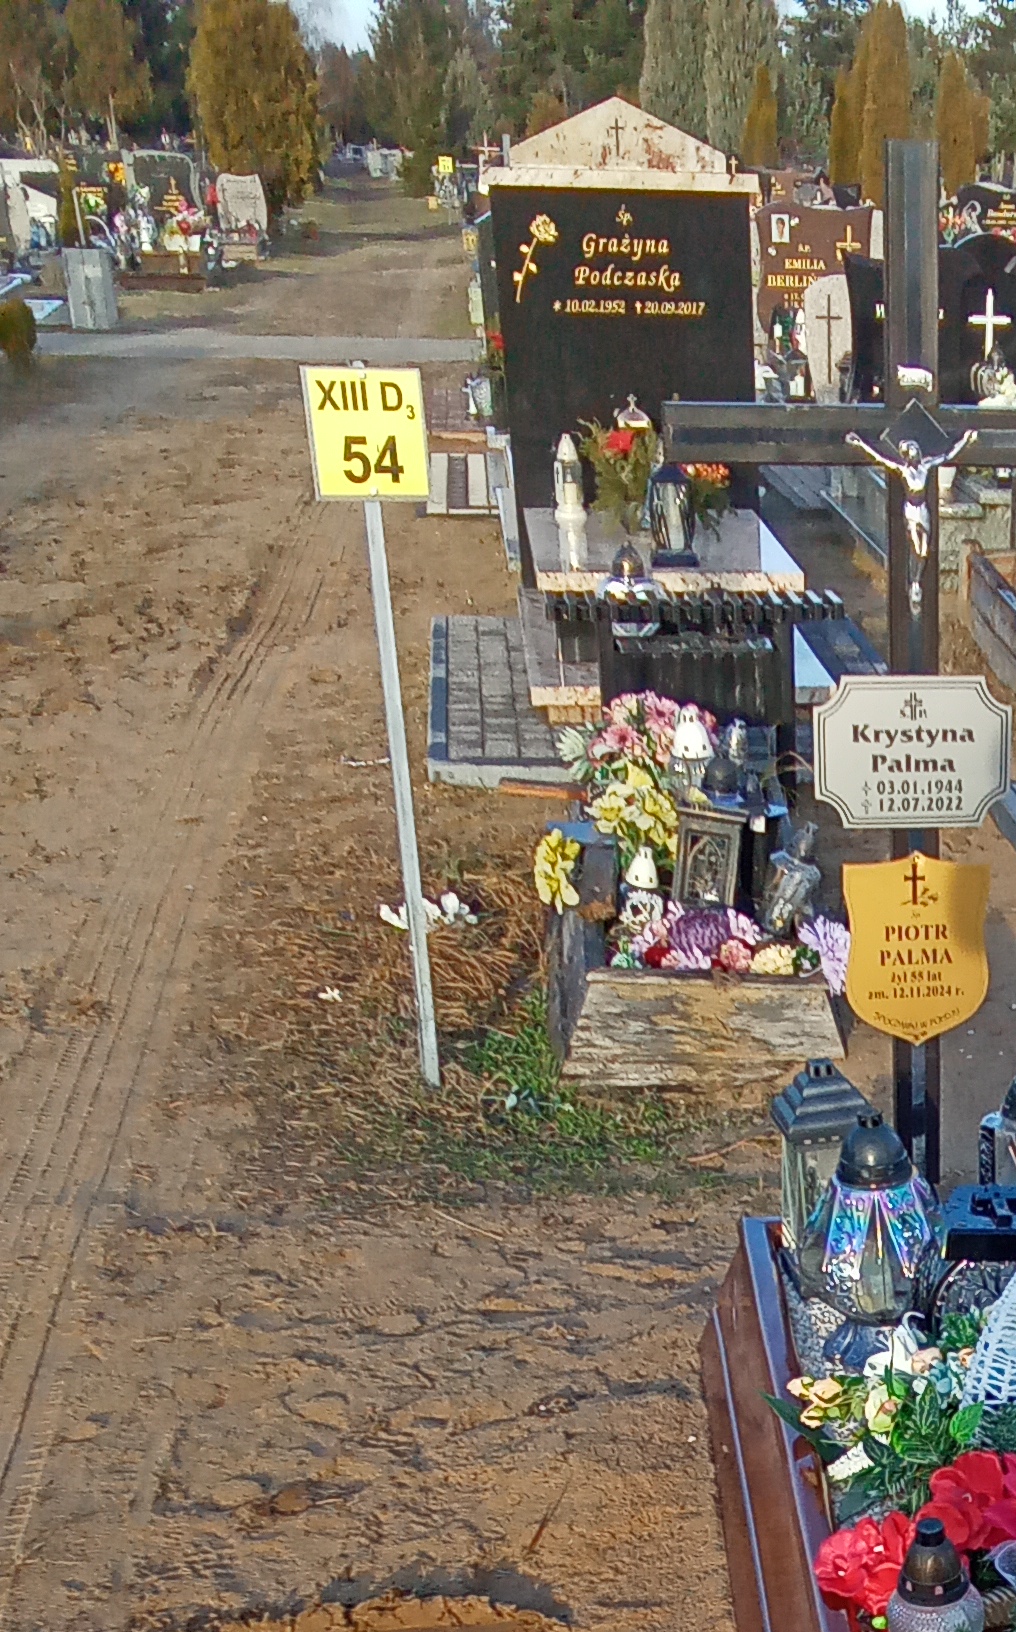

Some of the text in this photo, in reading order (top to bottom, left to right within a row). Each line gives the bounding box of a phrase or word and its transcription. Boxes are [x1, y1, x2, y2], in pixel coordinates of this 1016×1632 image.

[582, 233, 669, 261] Grażyna
[784, 258, 826, 270] EMILIA
[574, 264, 681, 292] Podczaska
[564, 299, 705, 315] 10.02.1952 20.09.2017
[315, 380, 369, 411] XIII
[343, 435, 404, 484] 54
[852, 723, 976, 749] Krystyna
[872, 753, 956, 773] Palma
[876, 778, 963, 796] 03.01.1944
[879, 795, 963, 813] 12.07.2022
[885, 923, 948, 942] PIOTR
[880, 947, 953, 967] PALMA
[911, 970, 924, 983] 55
[927, 970, 942, 982] lat
[893, 984, 952, 999] 12.11.2024
